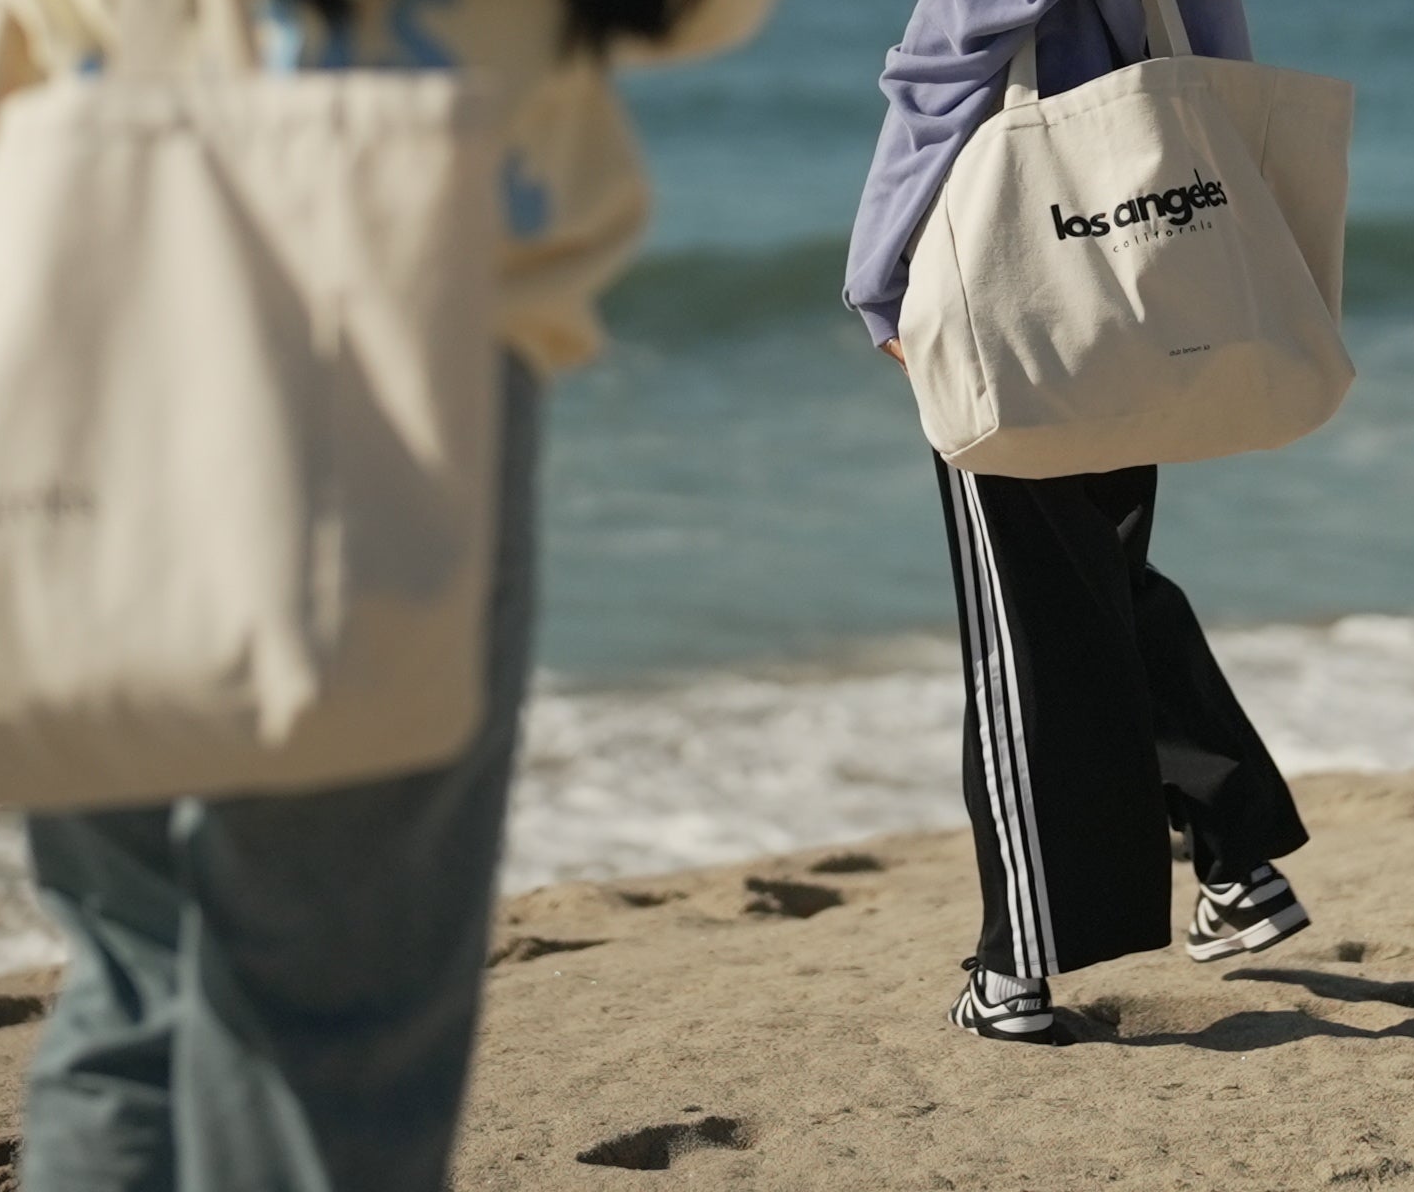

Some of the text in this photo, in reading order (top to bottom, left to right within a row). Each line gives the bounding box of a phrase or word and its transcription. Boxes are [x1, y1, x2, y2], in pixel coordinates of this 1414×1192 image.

[1050, 168, 1228, 241] los angeles
[1113, 220, 1213, 253] california
